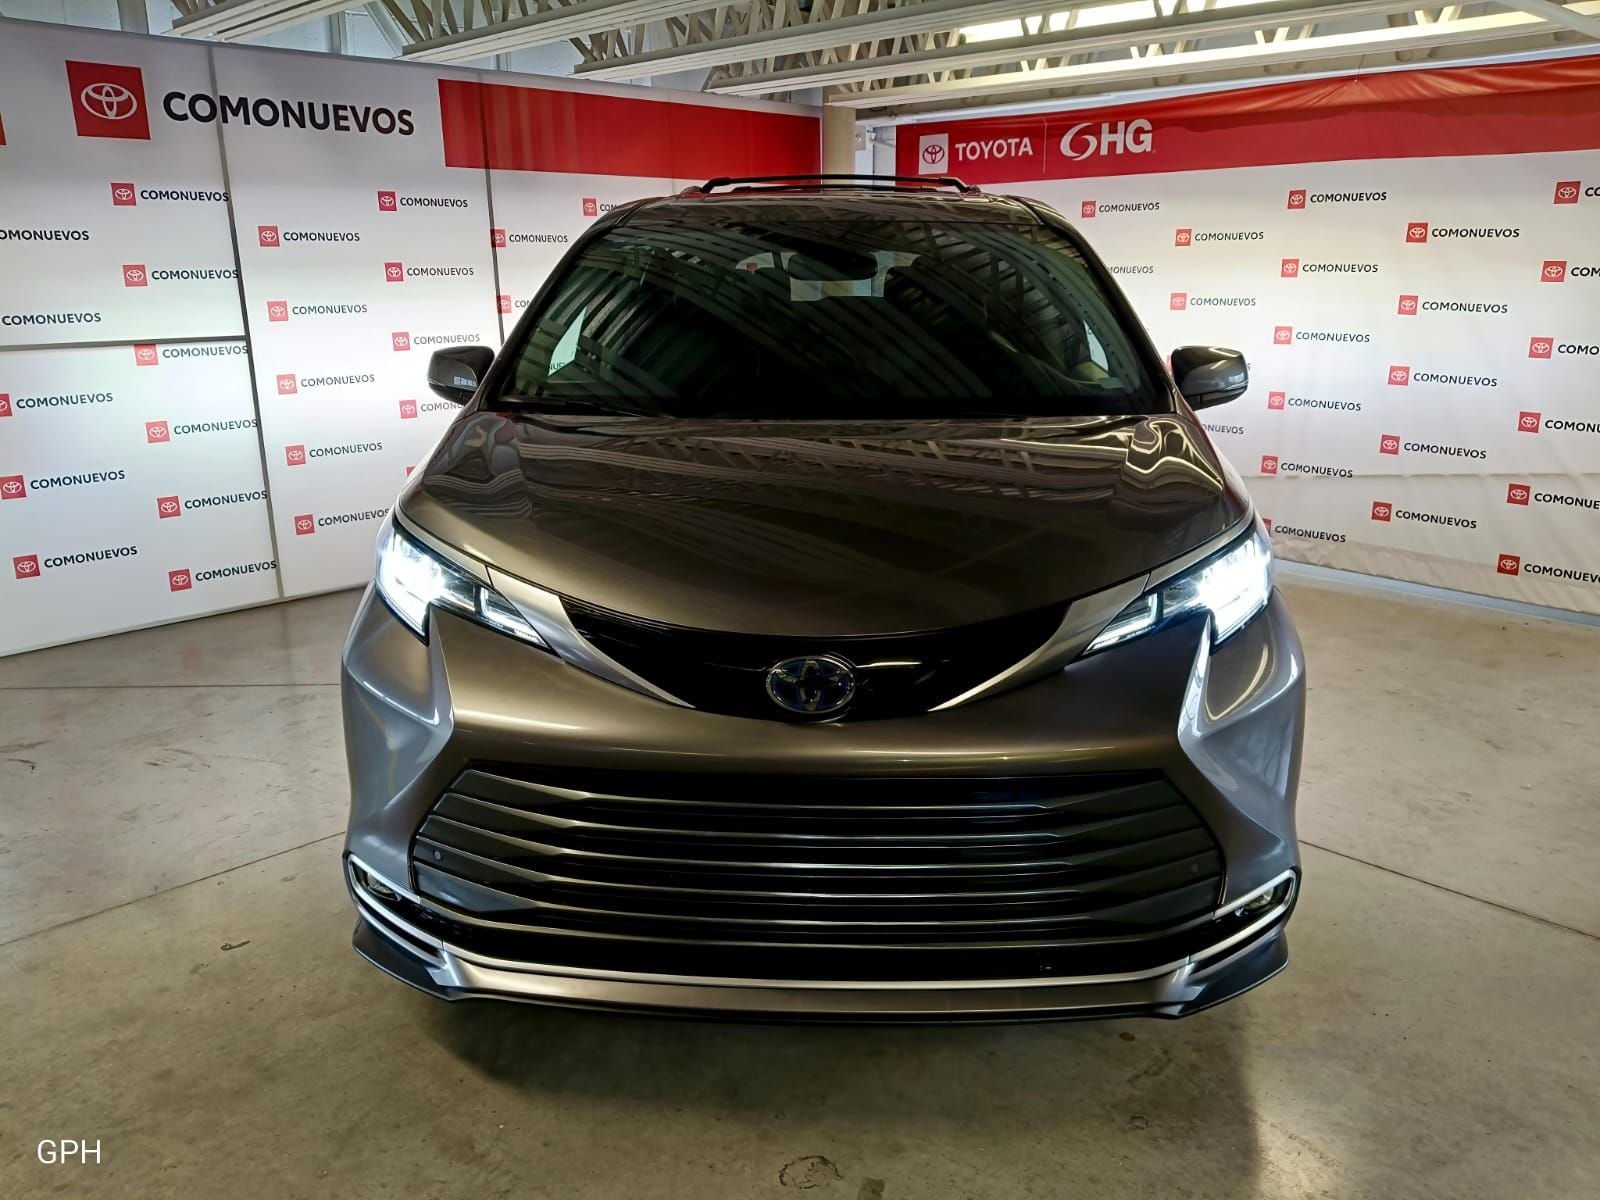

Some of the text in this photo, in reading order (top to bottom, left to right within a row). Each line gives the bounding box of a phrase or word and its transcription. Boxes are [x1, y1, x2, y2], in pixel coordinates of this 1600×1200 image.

[162, 91, 415, 136] COMONUEVOS
[955, 136, 1033, 161] TOYOTA
[140, 190, 230, 202] COMONUEVOS
[399, 197, 468, 208] COMONUEVOS
[1310, 191, 1387, 203] COMONUEVOS
[1098, 201, 1160, 213] COMONUEVOS
[282, 231, 361, 242] COMONUEVOS
[508, 234, 569, 243] COMONUEVOS
[1194, 231, 1264, 242] COMONUEVOS
[1431, 228, 1521, 238] COMONUEVOS
[151, 268, 239, 280] COMONUEVOS
[406, 267, 474, 277] COMONUEVOS
[1302, 263, 1379, 273] COMONUEVOS
[1570, 266, 1600, 277] COM
[1189, 297, 1257, 307] COMONUEVOS
[1422, 301, 1508, 314] COMONUEVOS
[291, 304, 368, 315] COMONUEVOS
[1, 312, 102, 326] COMONUEVOS
[413, 334, 481, 345] COMONUEVOS
[1295, 331, 1371, 343] COMONUEVOS
[162, 344, 249, 359] COMONUEVOS
[1557, 344, 1600, 356] COMO
[300, 373, 375, 388] COMONUEVOS
[1413, 372, 1498, 387] COMONUEVOS
[15, 392, 114, 410] COMONUEVOS
[1287, 397, 1362, 412] COMONUEVOS
[173, 418, 258, 436] COMONUEVOS
[308, 442, 383, 458] COMONUEVOS
[1403, 442, 1487, 460] COMONUEVOS
[1280, 462, 1354, 479] COMONUEVOS
[30, 469, 126, 490] COMONUEVOS
[184, 490, 268, 510] COMONUEVOS
[1395, 509, 1477, 529] COMONUEVOS
[1274, 525, 1346, 543] COMONUEVOS
[43, 545, 138, 569] COMONUEVOS
[195, 560, 278, 582] COMONUEVOS
[1523, 563, 1600, 584] COMONUEV
